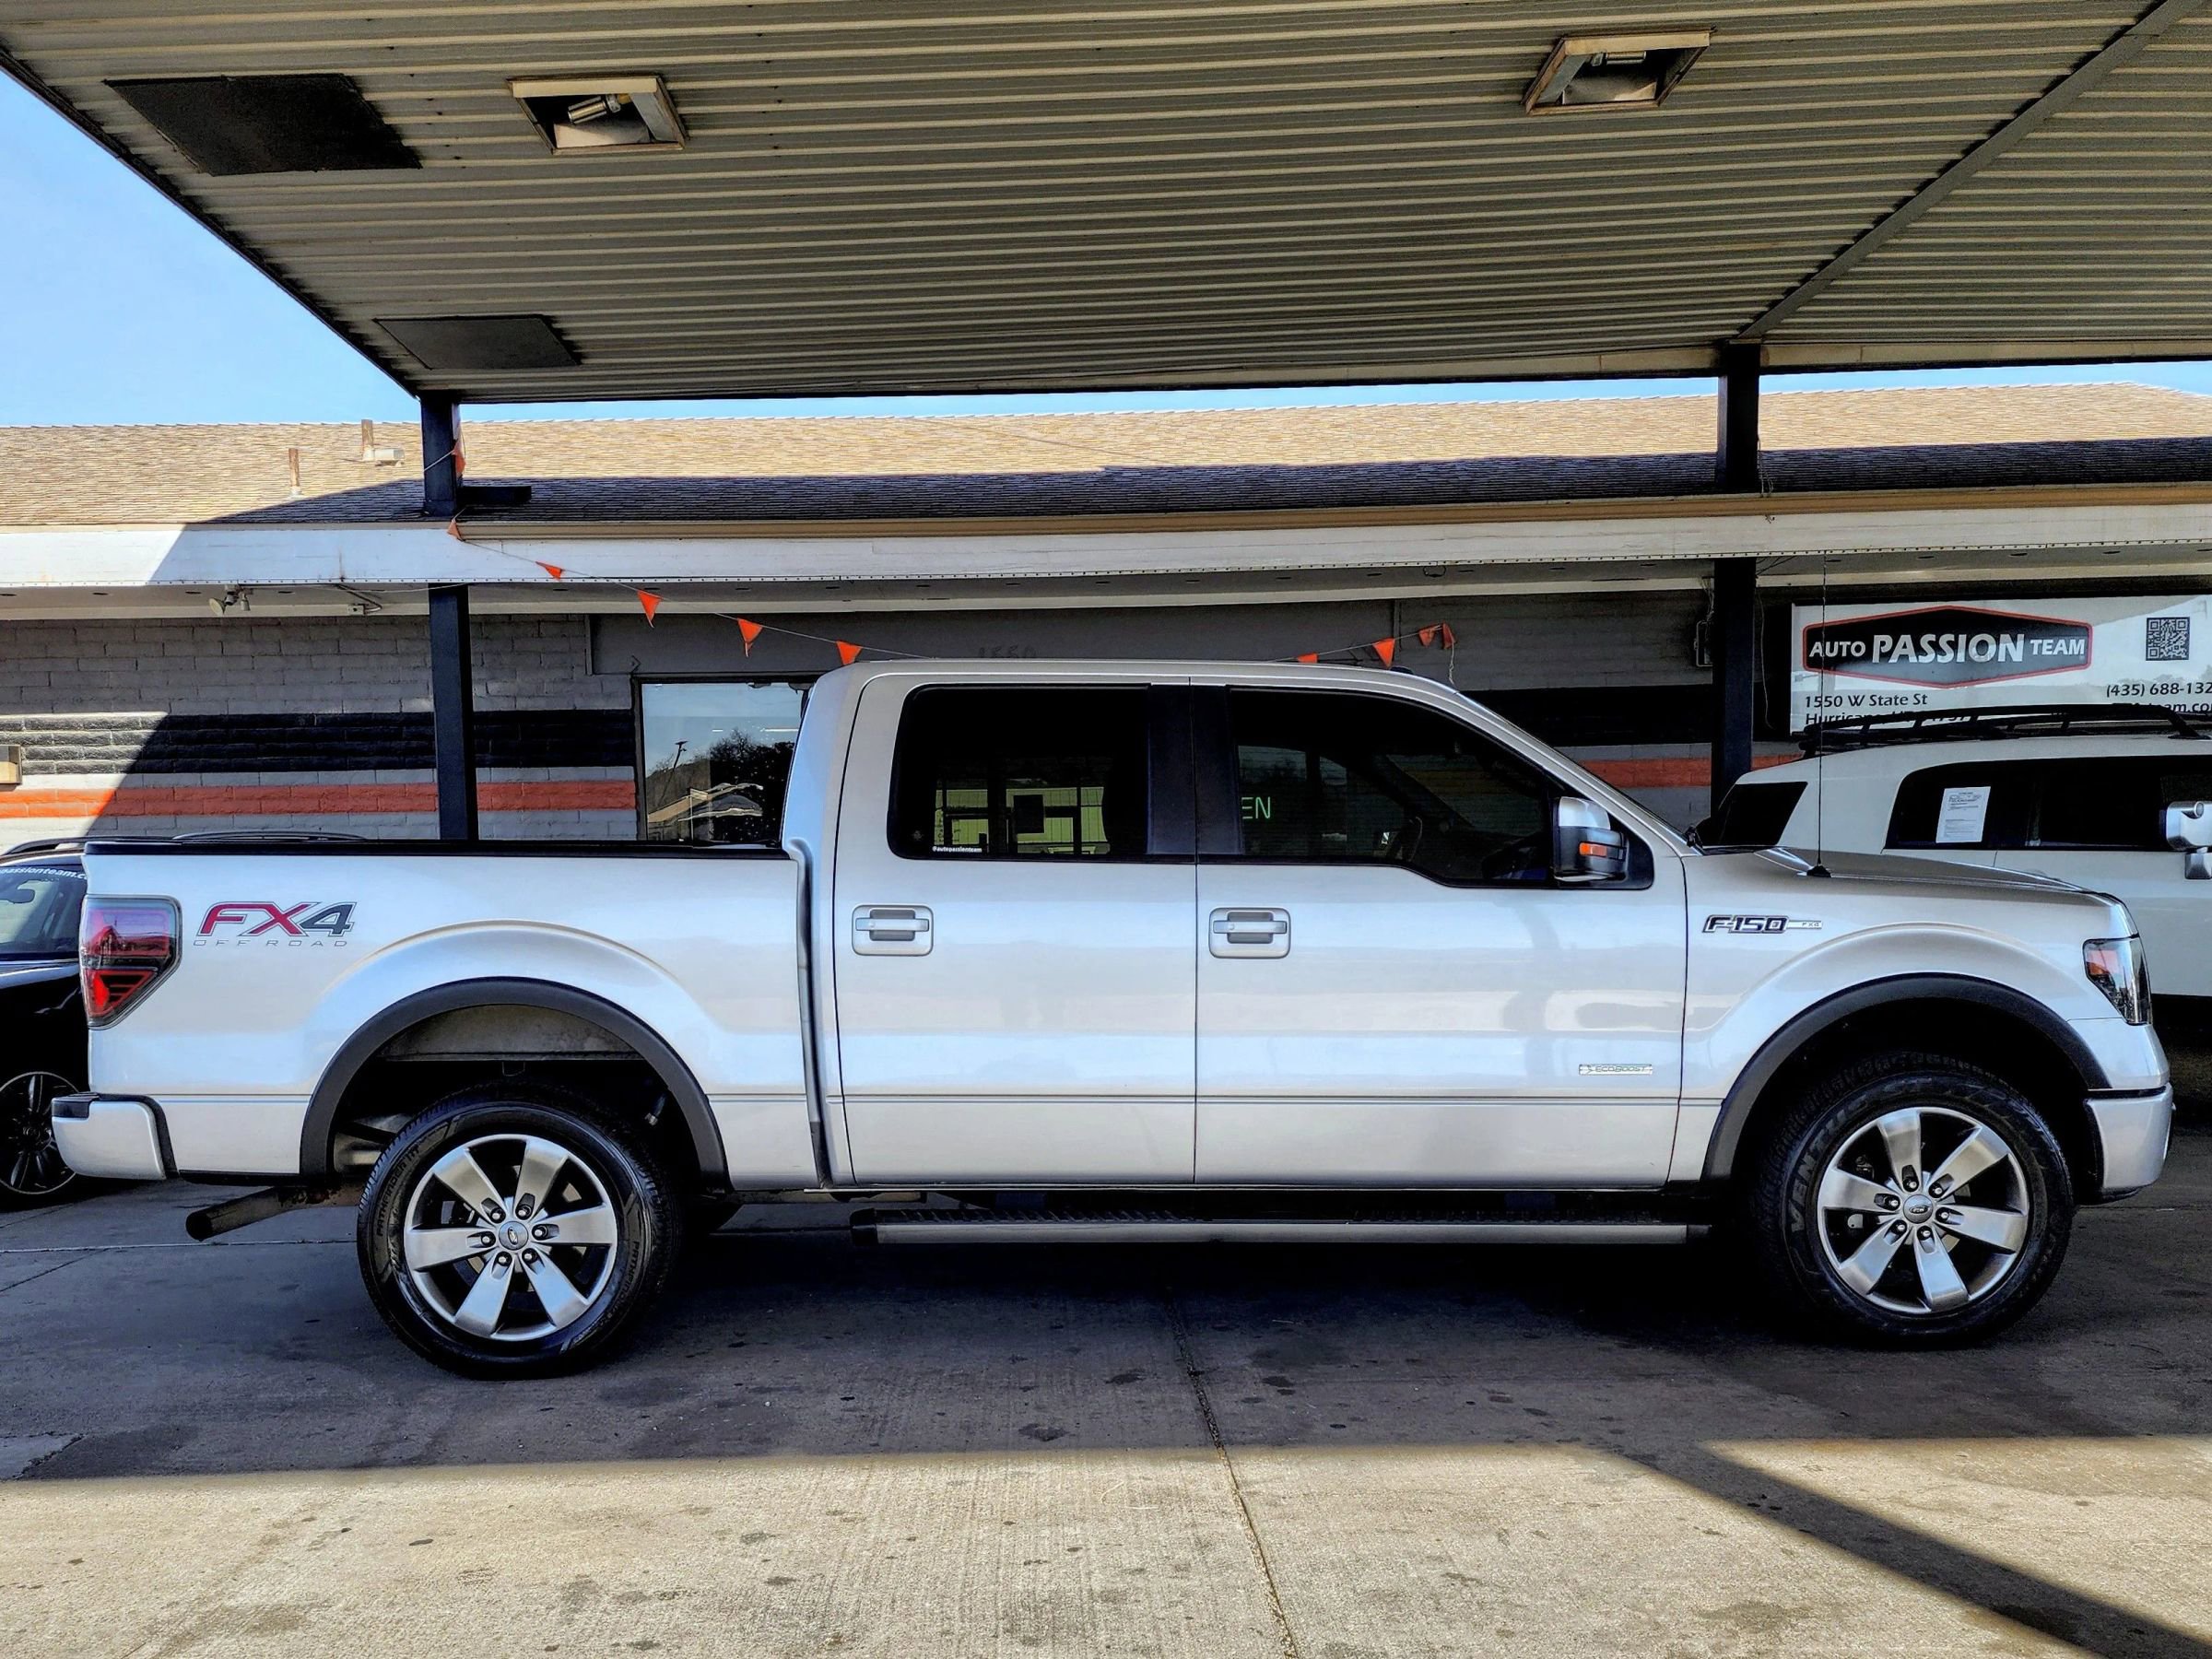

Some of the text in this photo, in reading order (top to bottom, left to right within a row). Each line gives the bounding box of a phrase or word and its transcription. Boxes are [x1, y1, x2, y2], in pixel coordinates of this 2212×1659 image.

[1809, 633, 2085, 663] AUTO PASSION TEAM
[1806, 693, 1928, 708] 1550 W State St
[2107, 684, 2145, 698] (435)
[196, 901, 358, 936] FX4
[1702, 914, 1789, 934] F-150
